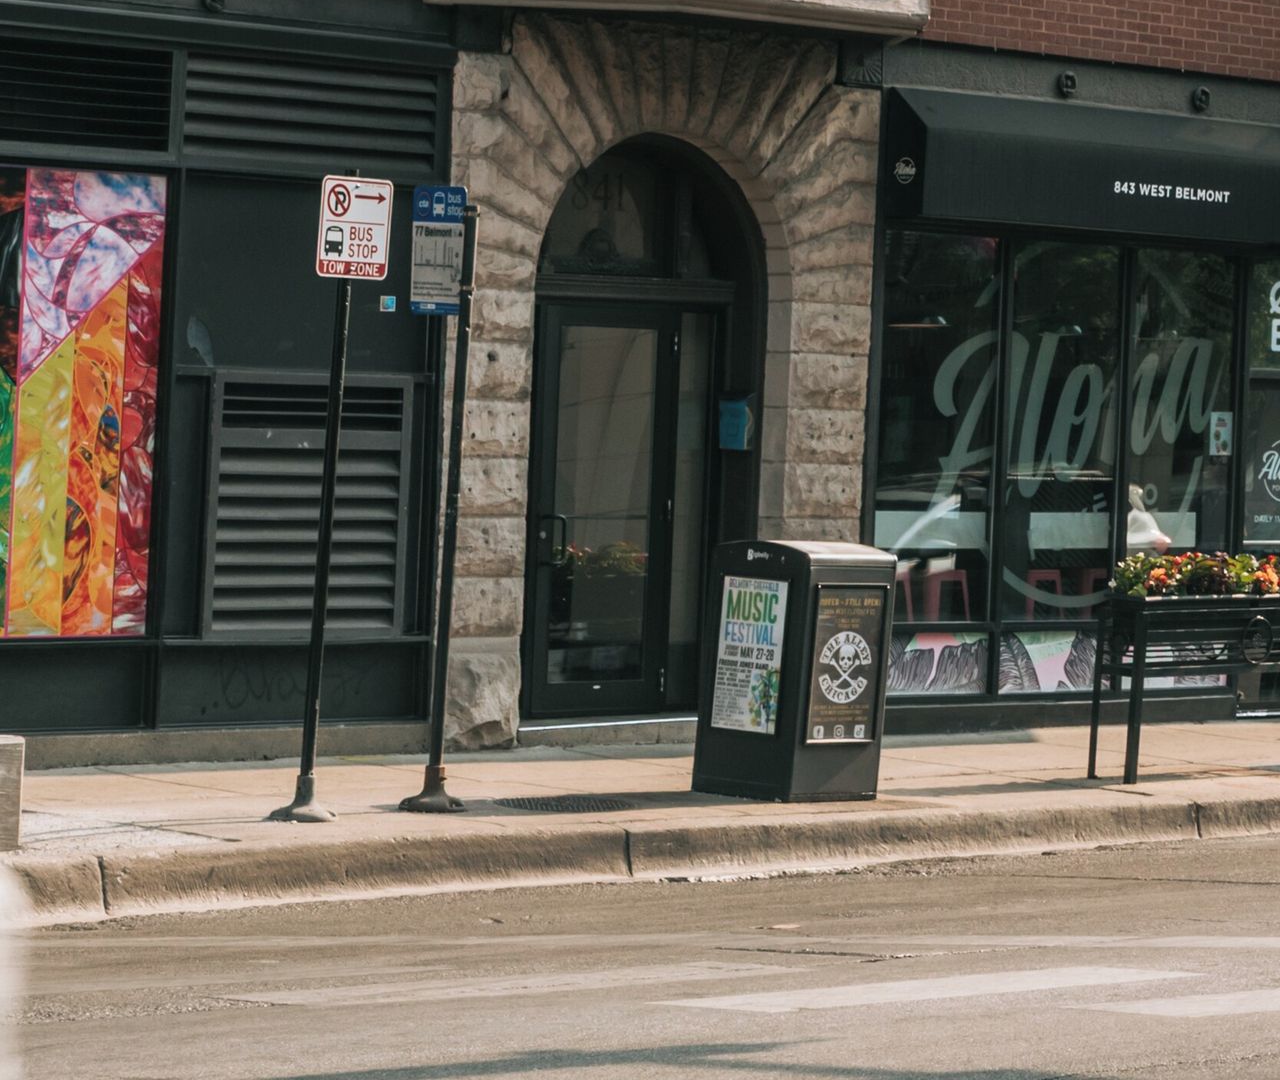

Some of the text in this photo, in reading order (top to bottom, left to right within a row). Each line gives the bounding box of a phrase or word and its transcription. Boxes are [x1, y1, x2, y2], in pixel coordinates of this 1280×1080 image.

[448, 191, 462, 204] bus
[1114, 180, 1231, 204] 843 WEST BELMONT
[349, 226, 373, 242] BUS
[414, 225, 424, 237] 77
[348, 242, 378, 260] STOP
[322, 261, 381, 277] TOW ZONE
[725, 588, 779, 624] MUSIC
[740, 645, 755, 659] MAY
[823, 633, 872, 663] THE ALLEY
[820, 676, 866, 702] CHICAGO
